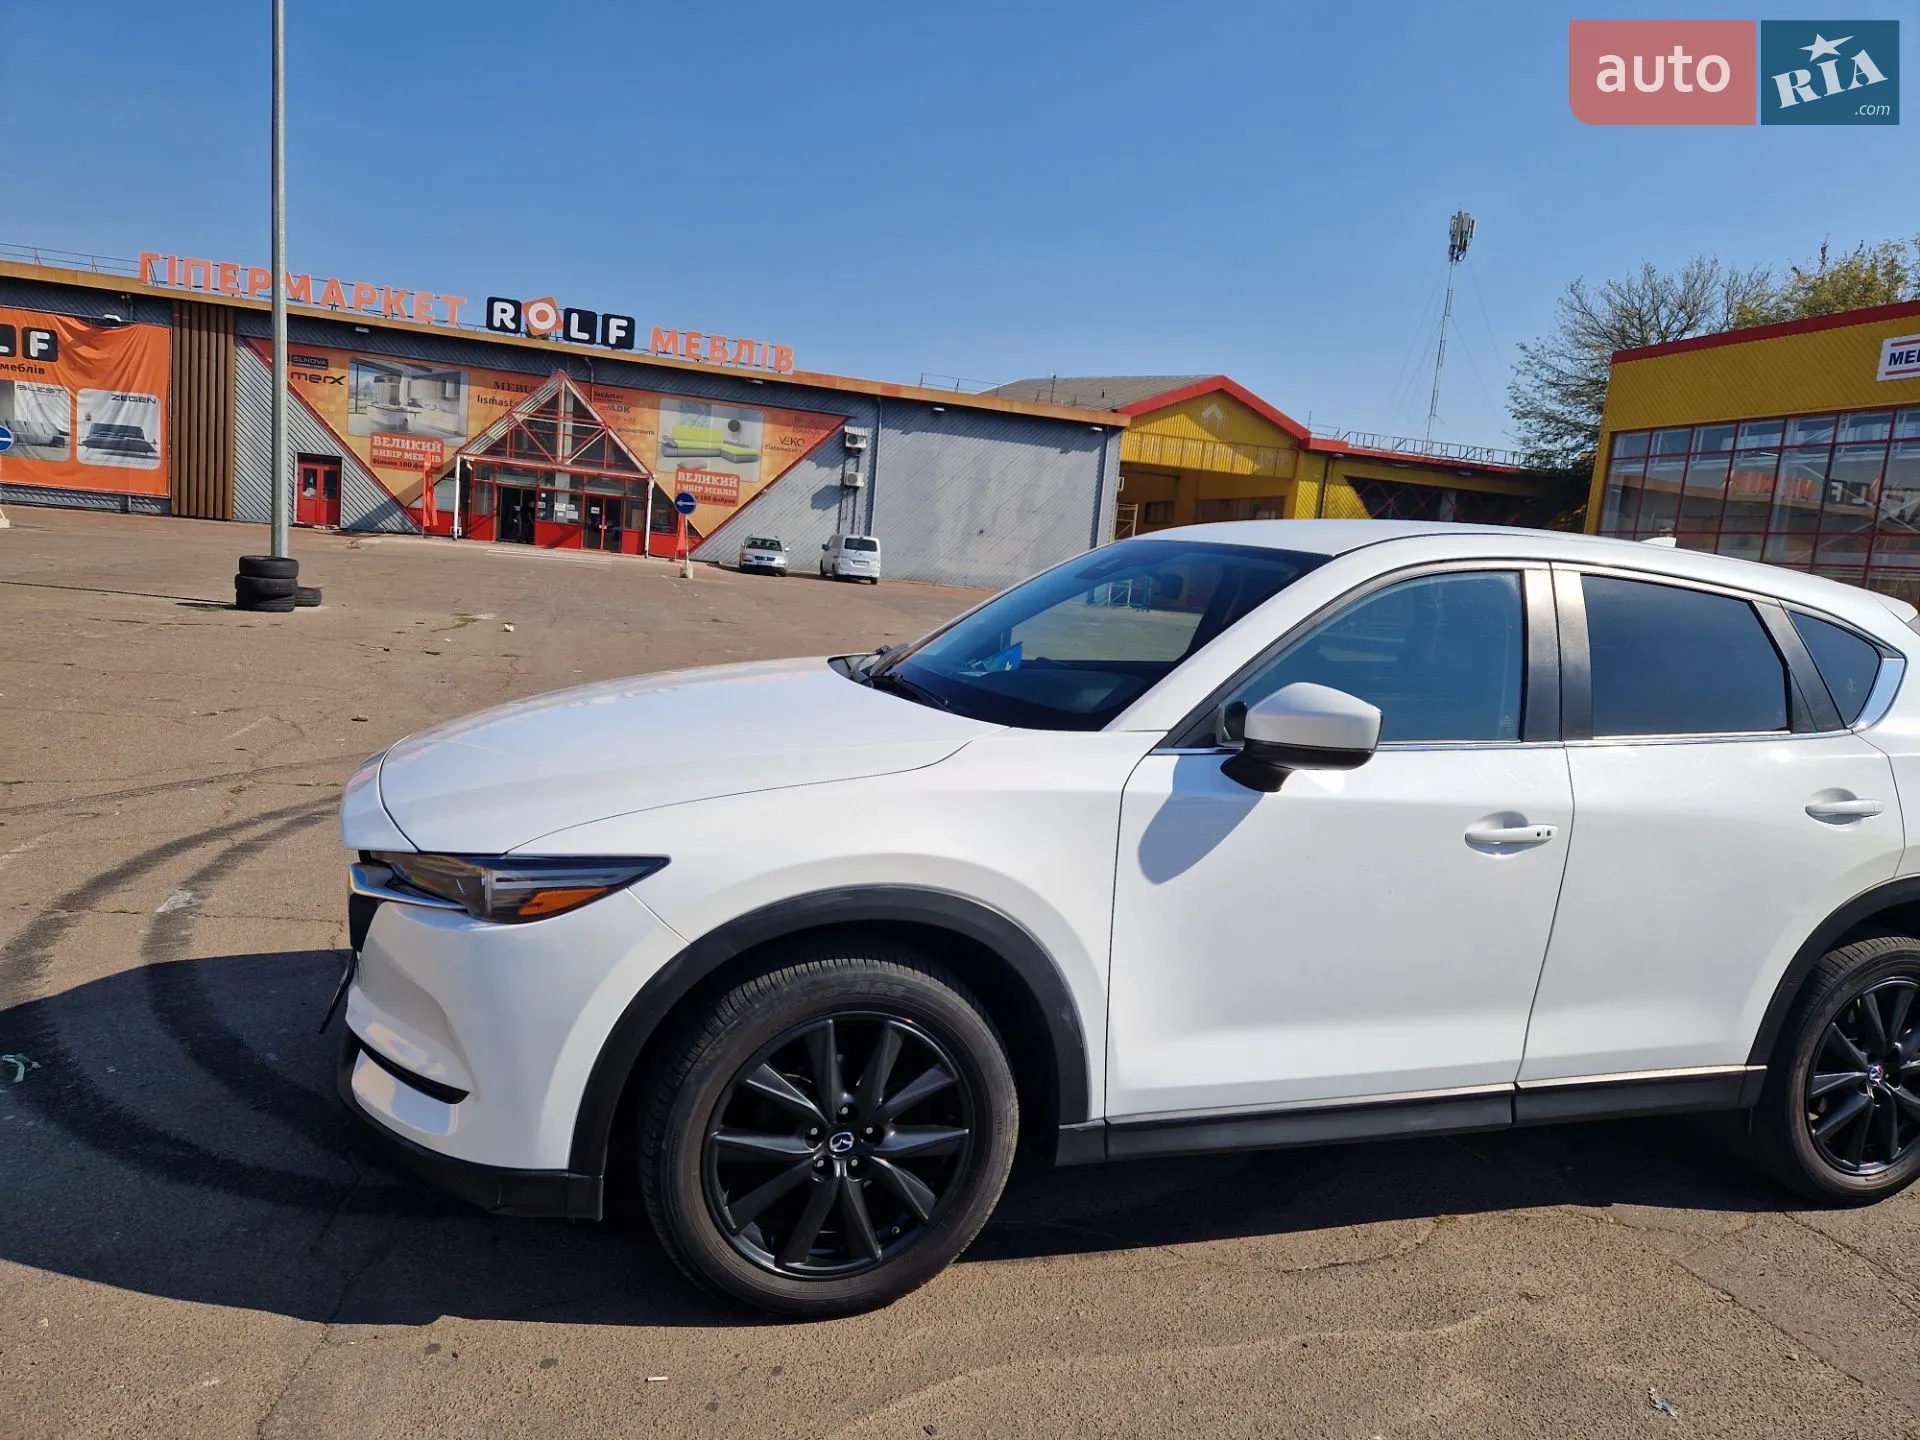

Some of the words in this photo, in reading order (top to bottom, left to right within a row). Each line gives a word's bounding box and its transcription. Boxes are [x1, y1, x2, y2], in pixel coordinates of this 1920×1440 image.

[139, 251, 467, 325] ГІПЕРМАРКЕТ
[491, 300, 629, 346] ROLF
[650, 326, 795, 373] МЕБЛІВ
[290, 371, 346, 385] merx
[111, 393, 157, 404] ZEGEN
[373, 435, 441, 452] ВЕЛИКИЙ
[404, 452, 441, 463] МЕБІВ
[677, 471, 738, 487] ВЕЛИКИЙ
